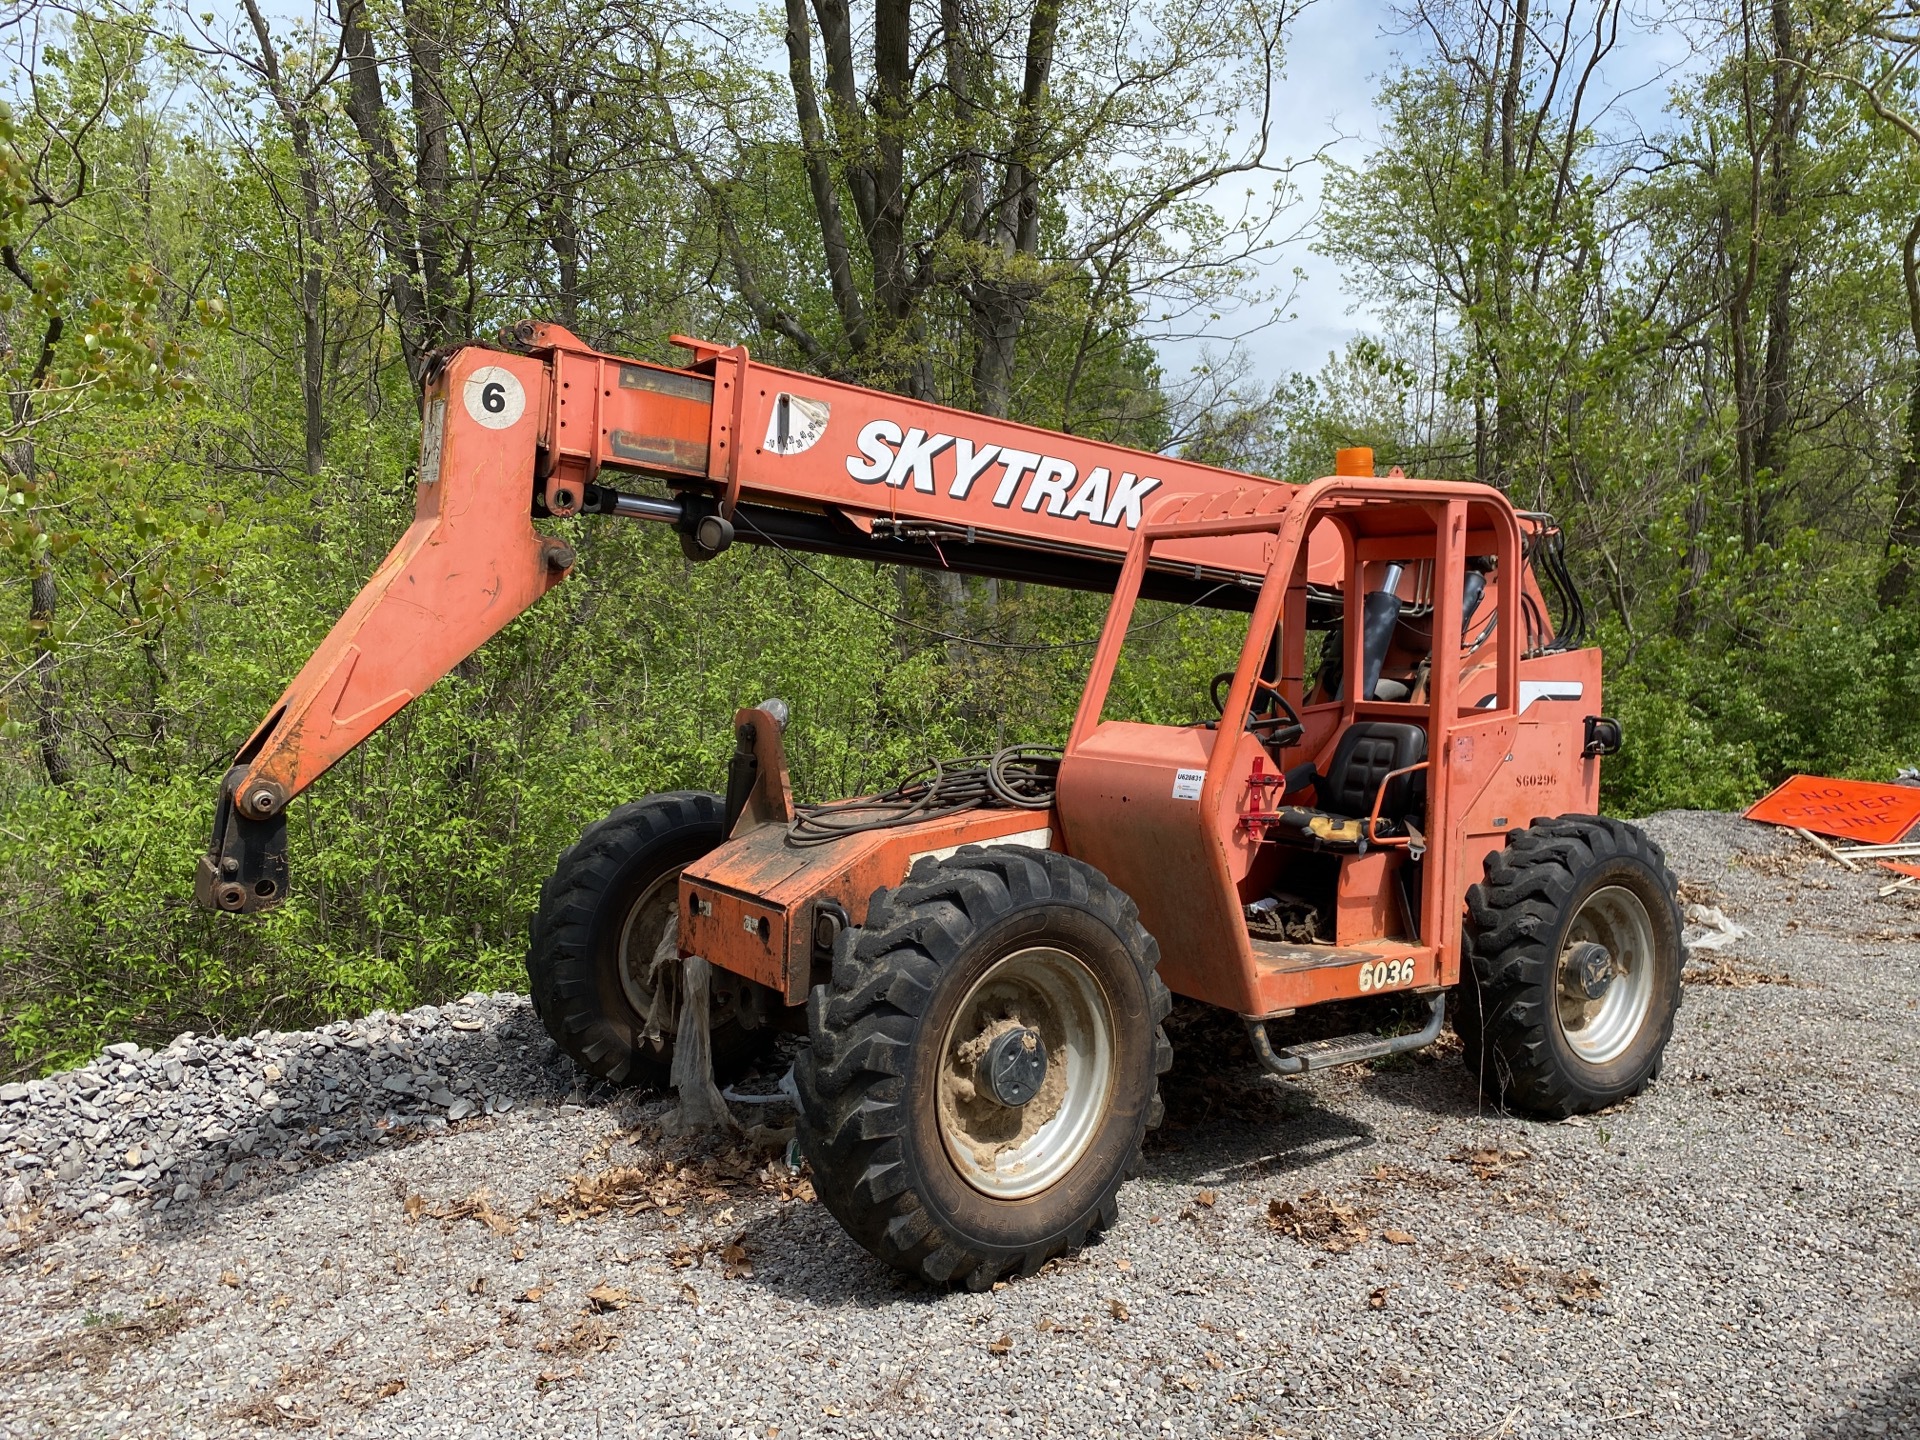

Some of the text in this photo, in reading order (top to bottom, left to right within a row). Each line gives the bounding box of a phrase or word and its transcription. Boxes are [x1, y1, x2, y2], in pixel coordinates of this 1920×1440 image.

[482, 383, 506, 413] 6
[846, 419, 1162, 529] SKYTRAK
[1516, 775, 1556, 787] S60296
[1782, 795, 1902, 816] CENTER
[1800, 789, 1843, 801] NO
[1823, 812, 1899, 829] LINE
[1358, 957, 1415, 992] 6036
